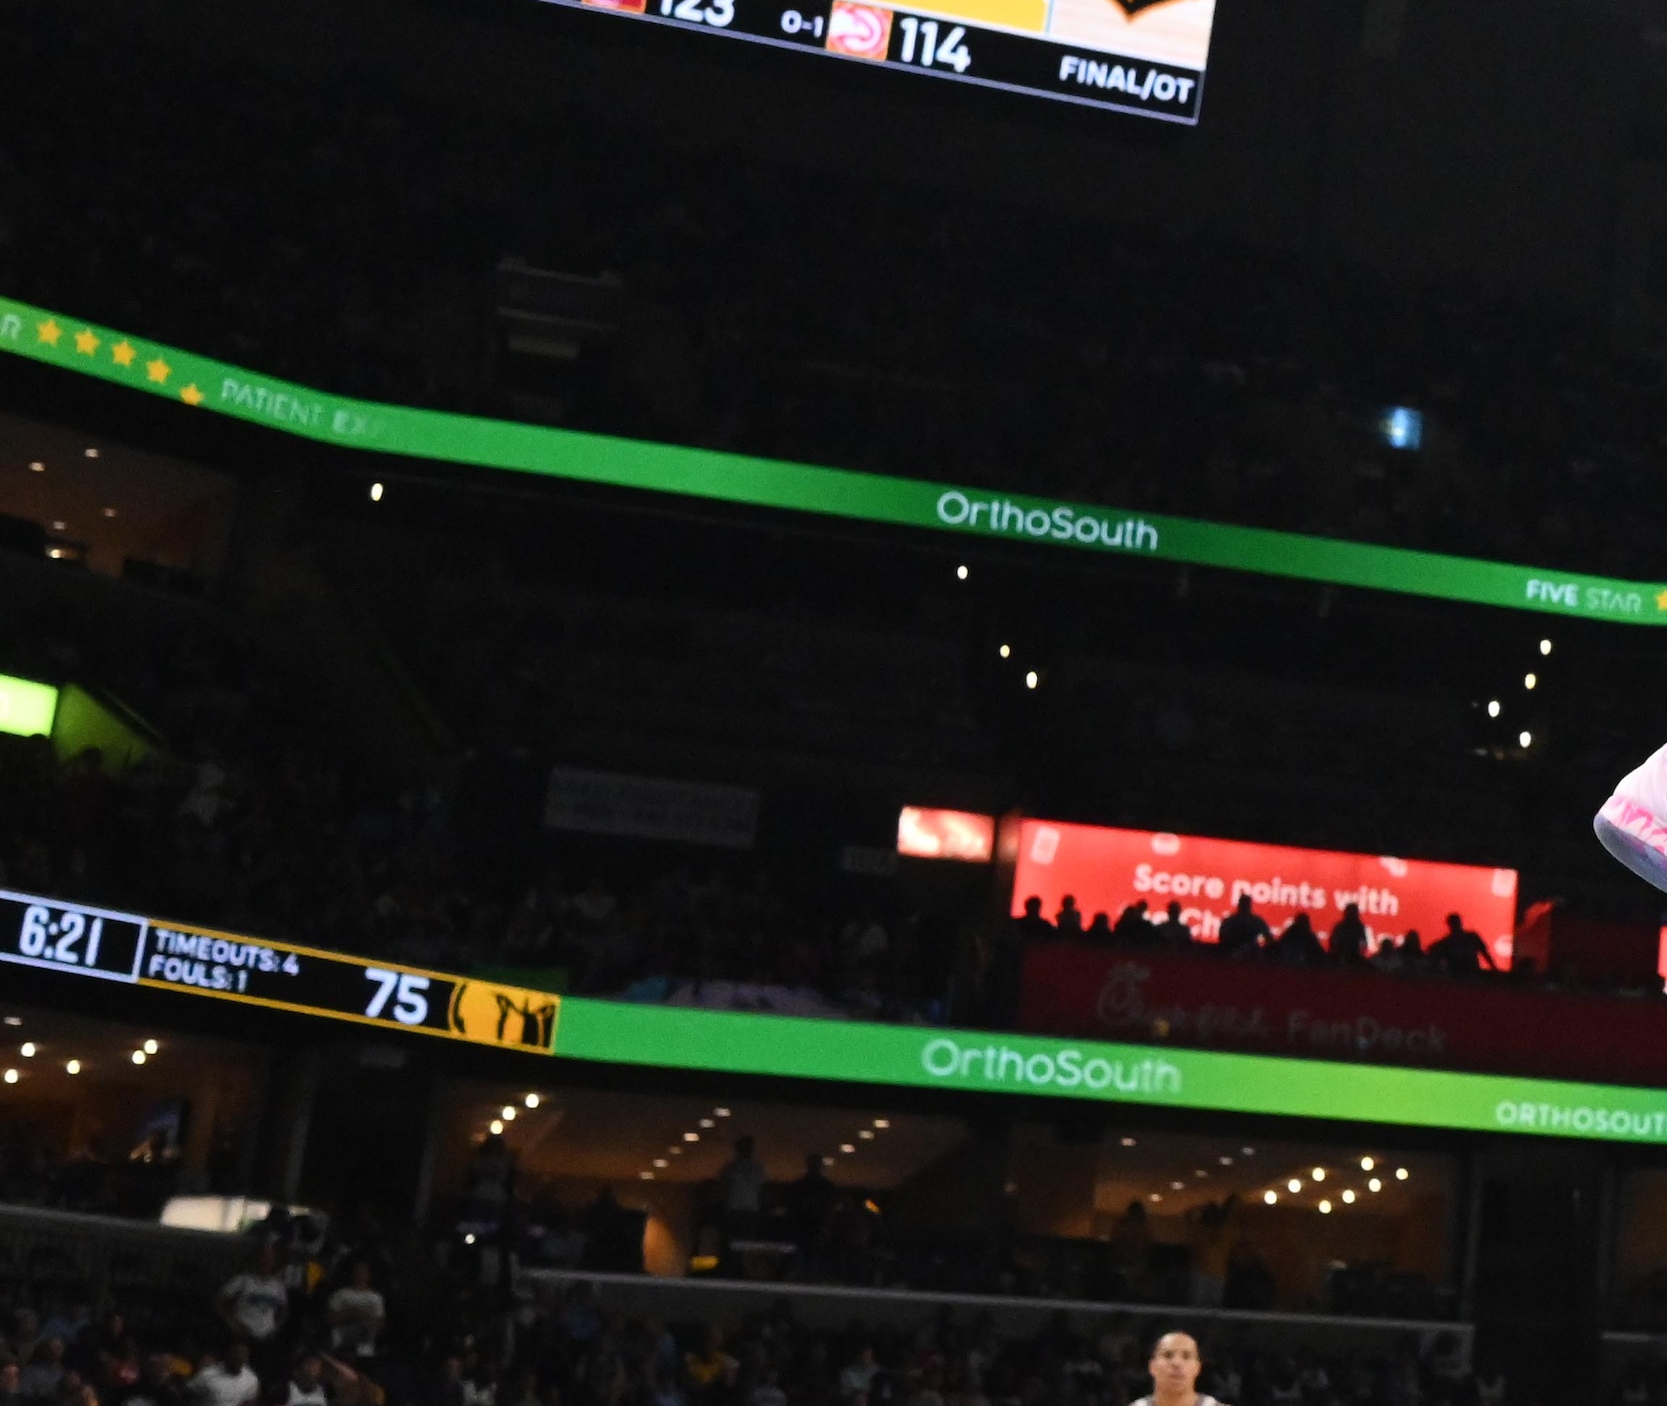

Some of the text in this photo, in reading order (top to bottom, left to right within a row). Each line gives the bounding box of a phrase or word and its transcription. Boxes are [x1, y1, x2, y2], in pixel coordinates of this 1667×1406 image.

[780, 10, 824, 38] 0-1
[900, 17, 971, 73] 114
[1059, 55, 1195, 104] FINAL/OT
[221, 377, 322, 426] PATIENT
[936, 490, 1159, 552] OrthoSouth
[1526, 578, 1643, 614] FIVE STAR
[1133, 862, 1399, 917] Score points with
[19, 904, 103, 968] 6:21
[156, 929, 300, 977] TIMEOUTS: 4
[149, 954, 248, 993] FOULS: 1
[364, 968, 430, 1026] 75
[921, 1038, 1182, 1095] OrthoSouth
